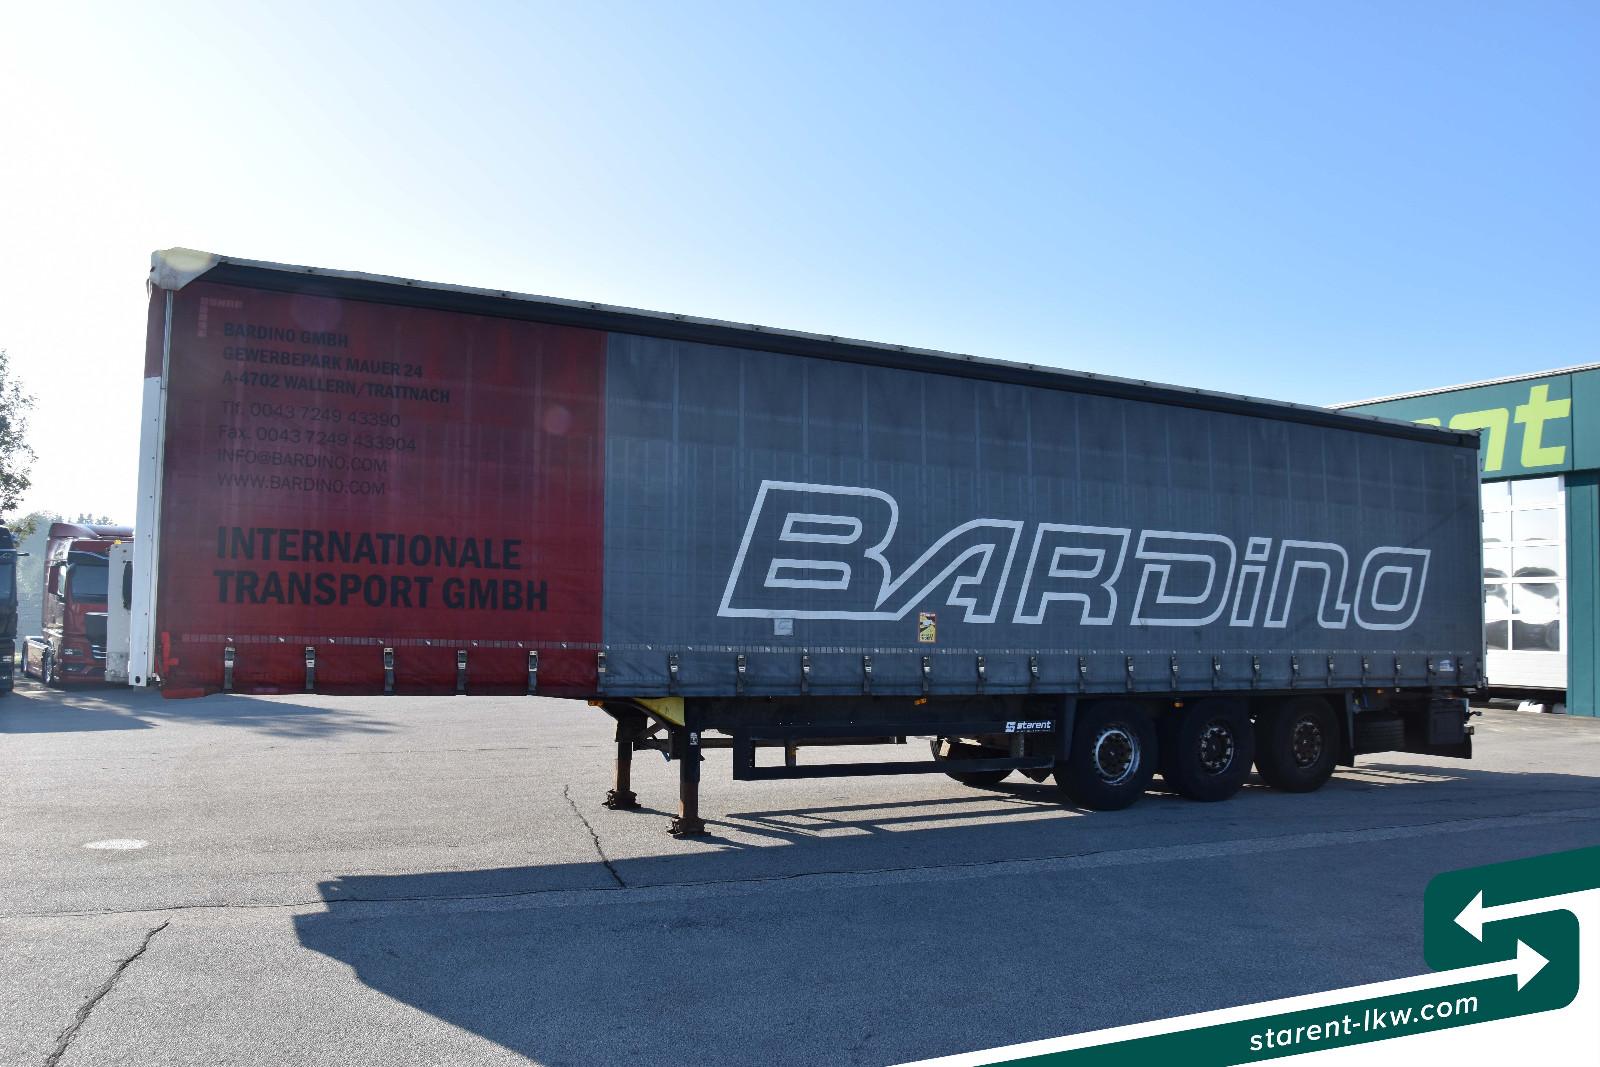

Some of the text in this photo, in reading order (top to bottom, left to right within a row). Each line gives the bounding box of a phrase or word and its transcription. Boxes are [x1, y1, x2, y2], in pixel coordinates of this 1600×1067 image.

[223, 322, 348, 348] BARDINO GMBH
[223, 346, 423, 378] GEWERBEPARK MAUER 24
[222, 371, 279, 388] A-4702
[250, 401, 297, 420] 0043
[301, 406, 342, 423] 7249
[347, 409, 401, 427] 43390
[256, 426, 302, 443] 0043
[306, 430, 348, 448] 7249
[353, 433, 416, 452] 433904
[218, 448, 388, 473] INFO@BARDINO.COM
[217, 472, 386, 495] WWW.BARDINO.COM
[217, 526, 522, 570] INTERNATIONALE
[214, 570, 548, 611] TRANSPORT GMBH
[1017, 720, 1051, 729] starent
